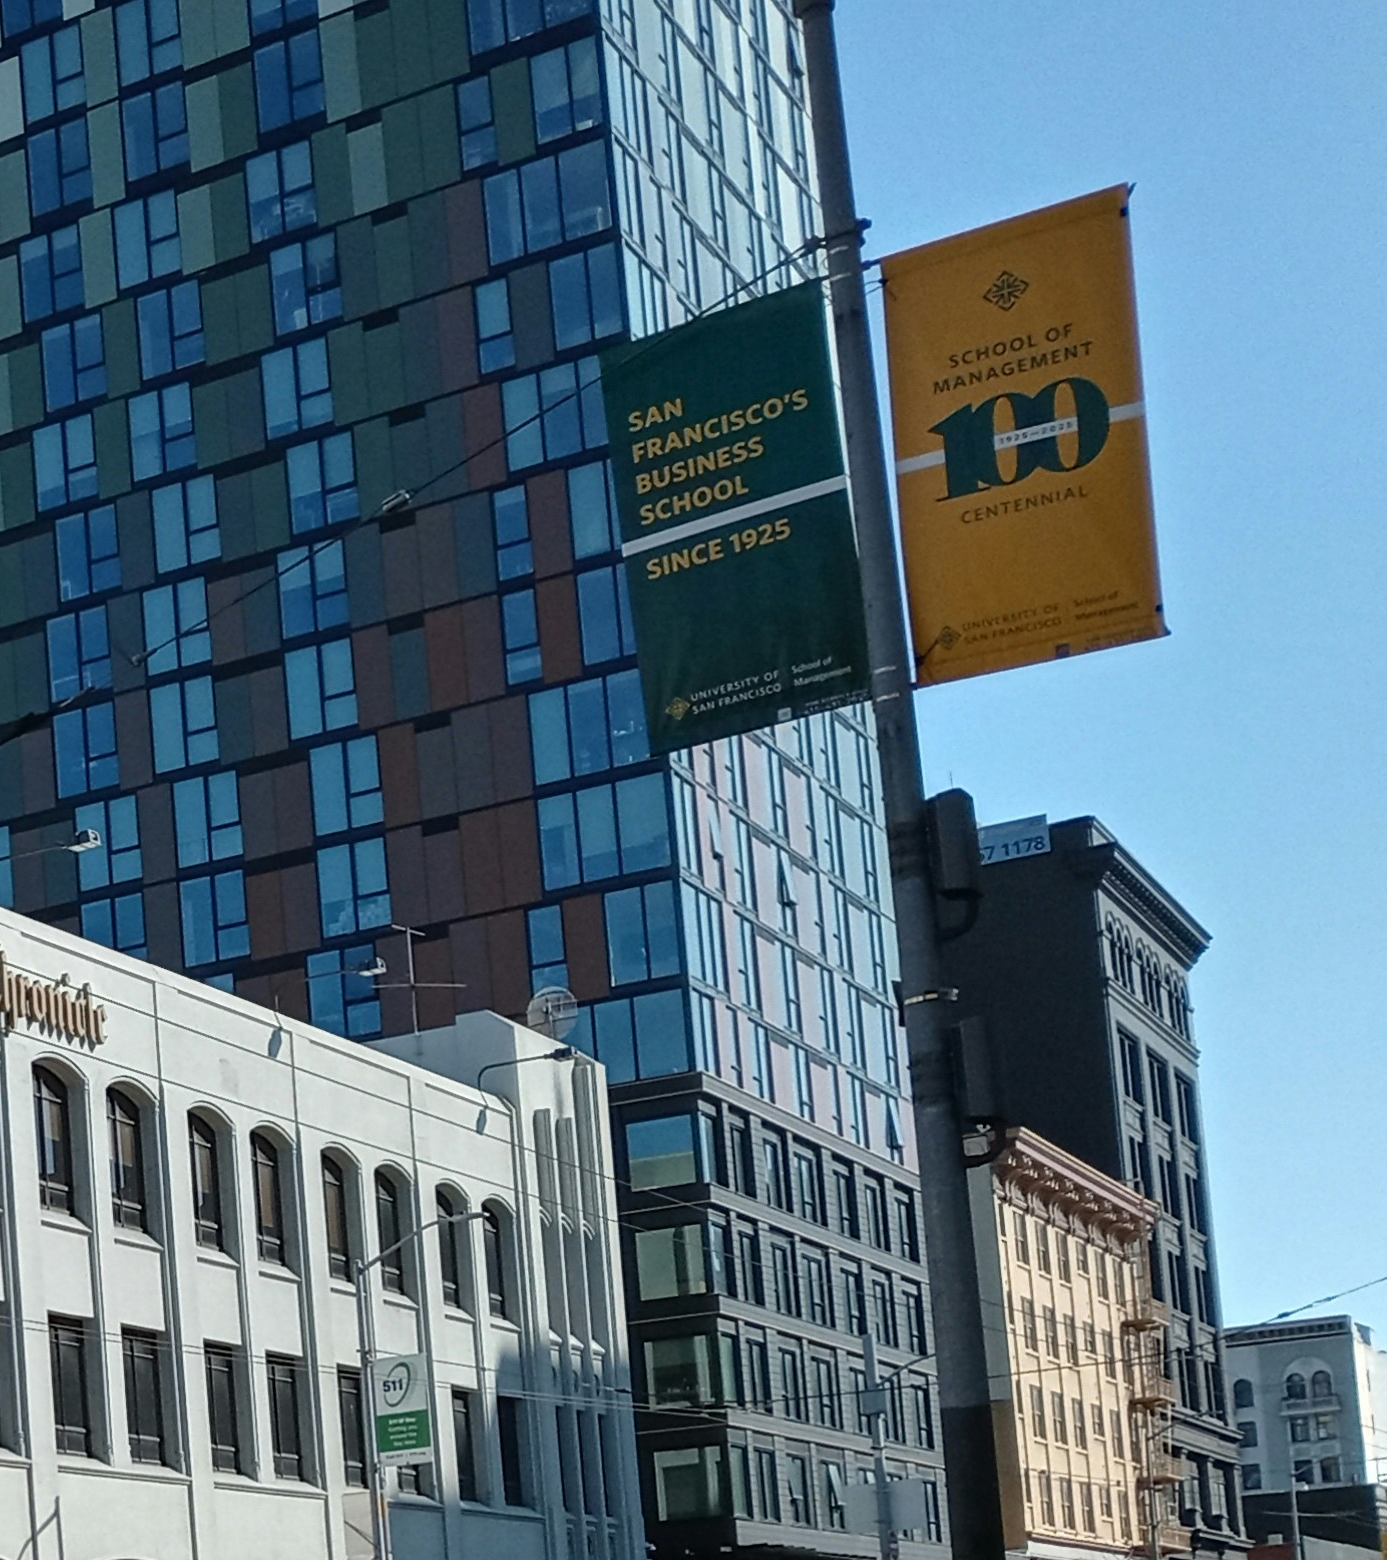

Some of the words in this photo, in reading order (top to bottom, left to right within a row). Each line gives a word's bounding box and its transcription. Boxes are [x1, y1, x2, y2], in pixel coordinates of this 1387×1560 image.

[948, 335, 1037, 369] SCHOOL
[1045, 323, 1073, 343] OF
[932, 341, 1093, 394] MANAGEMENT
[628, 398, 684, 433] SAN
[631, 388, 809, 464] FRANCISCO'S
[927, 376, 1111, 502] 100
[635, 436, 765, 495] BUSINESS
[639, 475, 750, 526] SCHOOL
[961, 486, 1089, 525] CENTENNIAL
[646, 538, 725, 580] SINCE
[729, 518, 792, 553] 1925
[962, 608, 1038, 632] UNIVERSITY
[1043, 603, 1060, 614] OF
[964, 633, 989, 645] SAN
[992, 616, 1063, 640] FRANCISCO
[690, 674, 760, 702] UNIVERSITY
[763, 669, 779, 682] OF
[791, 661, 821, 675] School
[691, 701, 716, 715] SAN
[718, 682, 782, 708] FRANCISCO
[1001, 835, 1046, 857] 1178
[382, 1378, 404, 1393] 511
